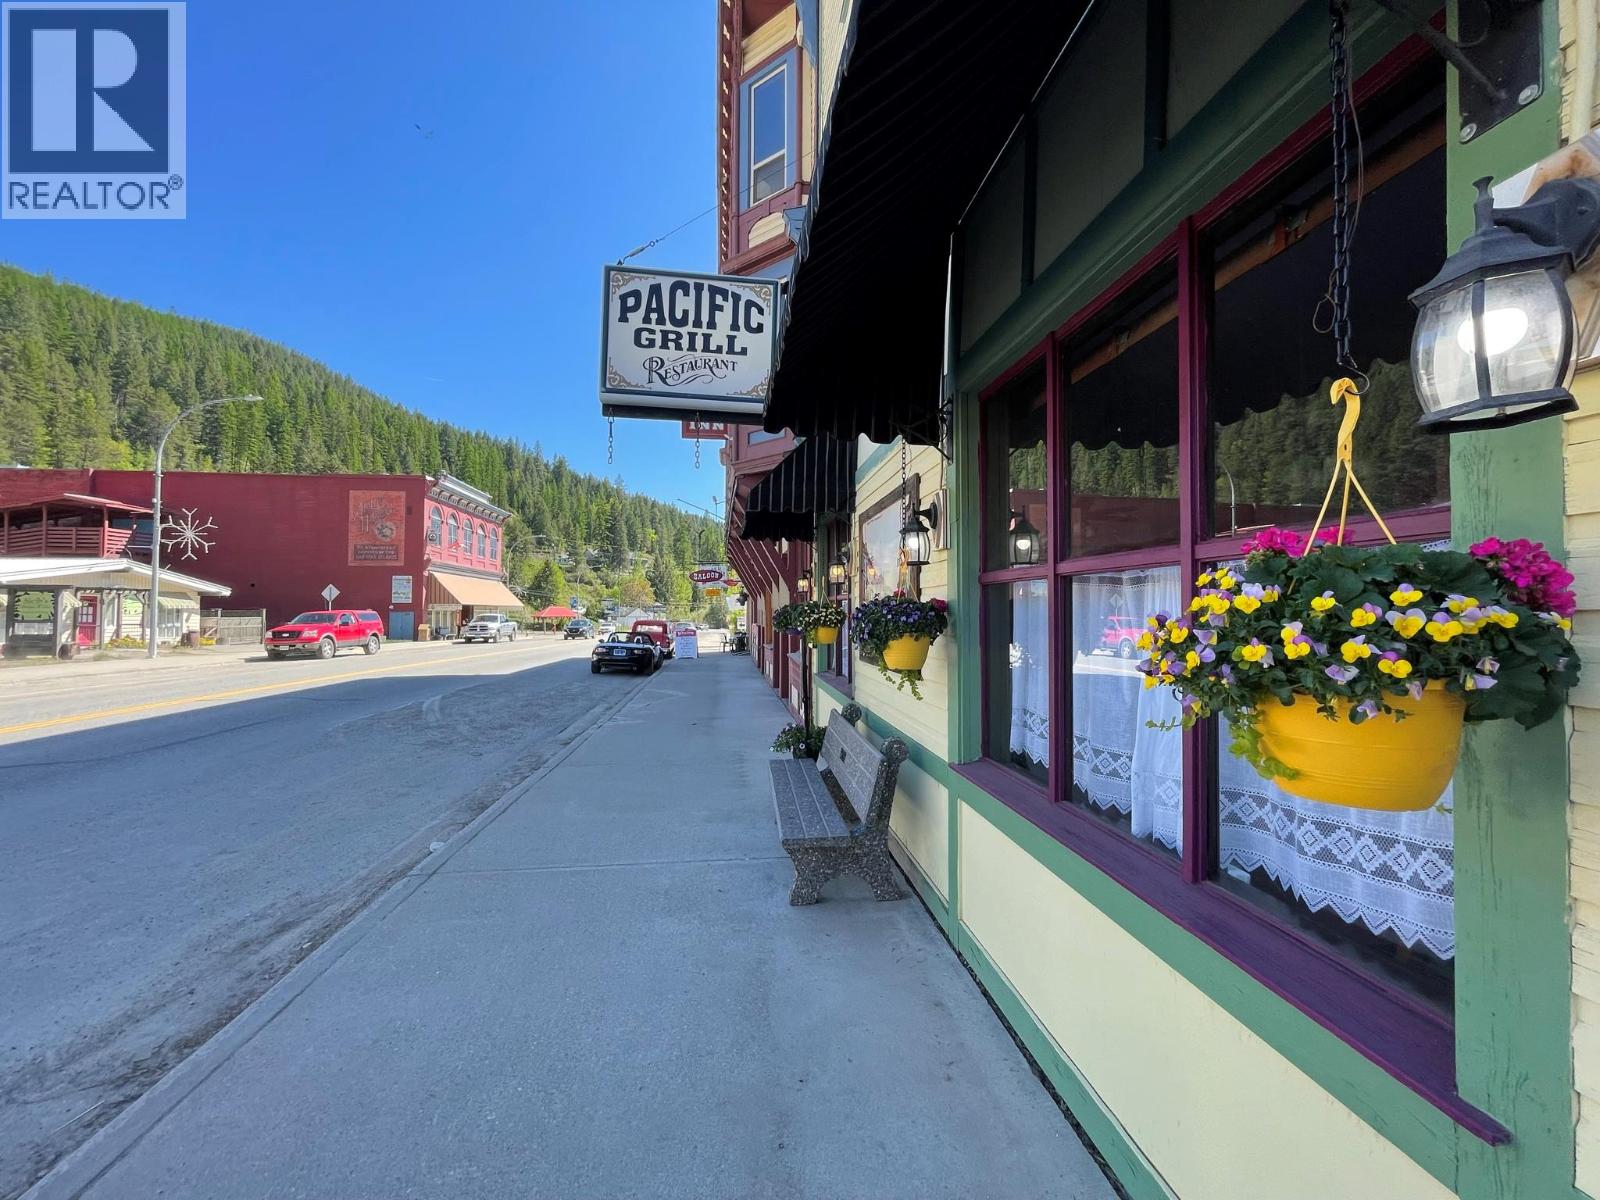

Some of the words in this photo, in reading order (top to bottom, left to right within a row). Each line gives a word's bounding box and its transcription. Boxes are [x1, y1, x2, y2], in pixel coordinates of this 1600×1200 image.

[618, 280, 765, 334] PACIFIC
[633, 327, 748, 356] GRILL
[693, 572, 719, 580] SALOON
